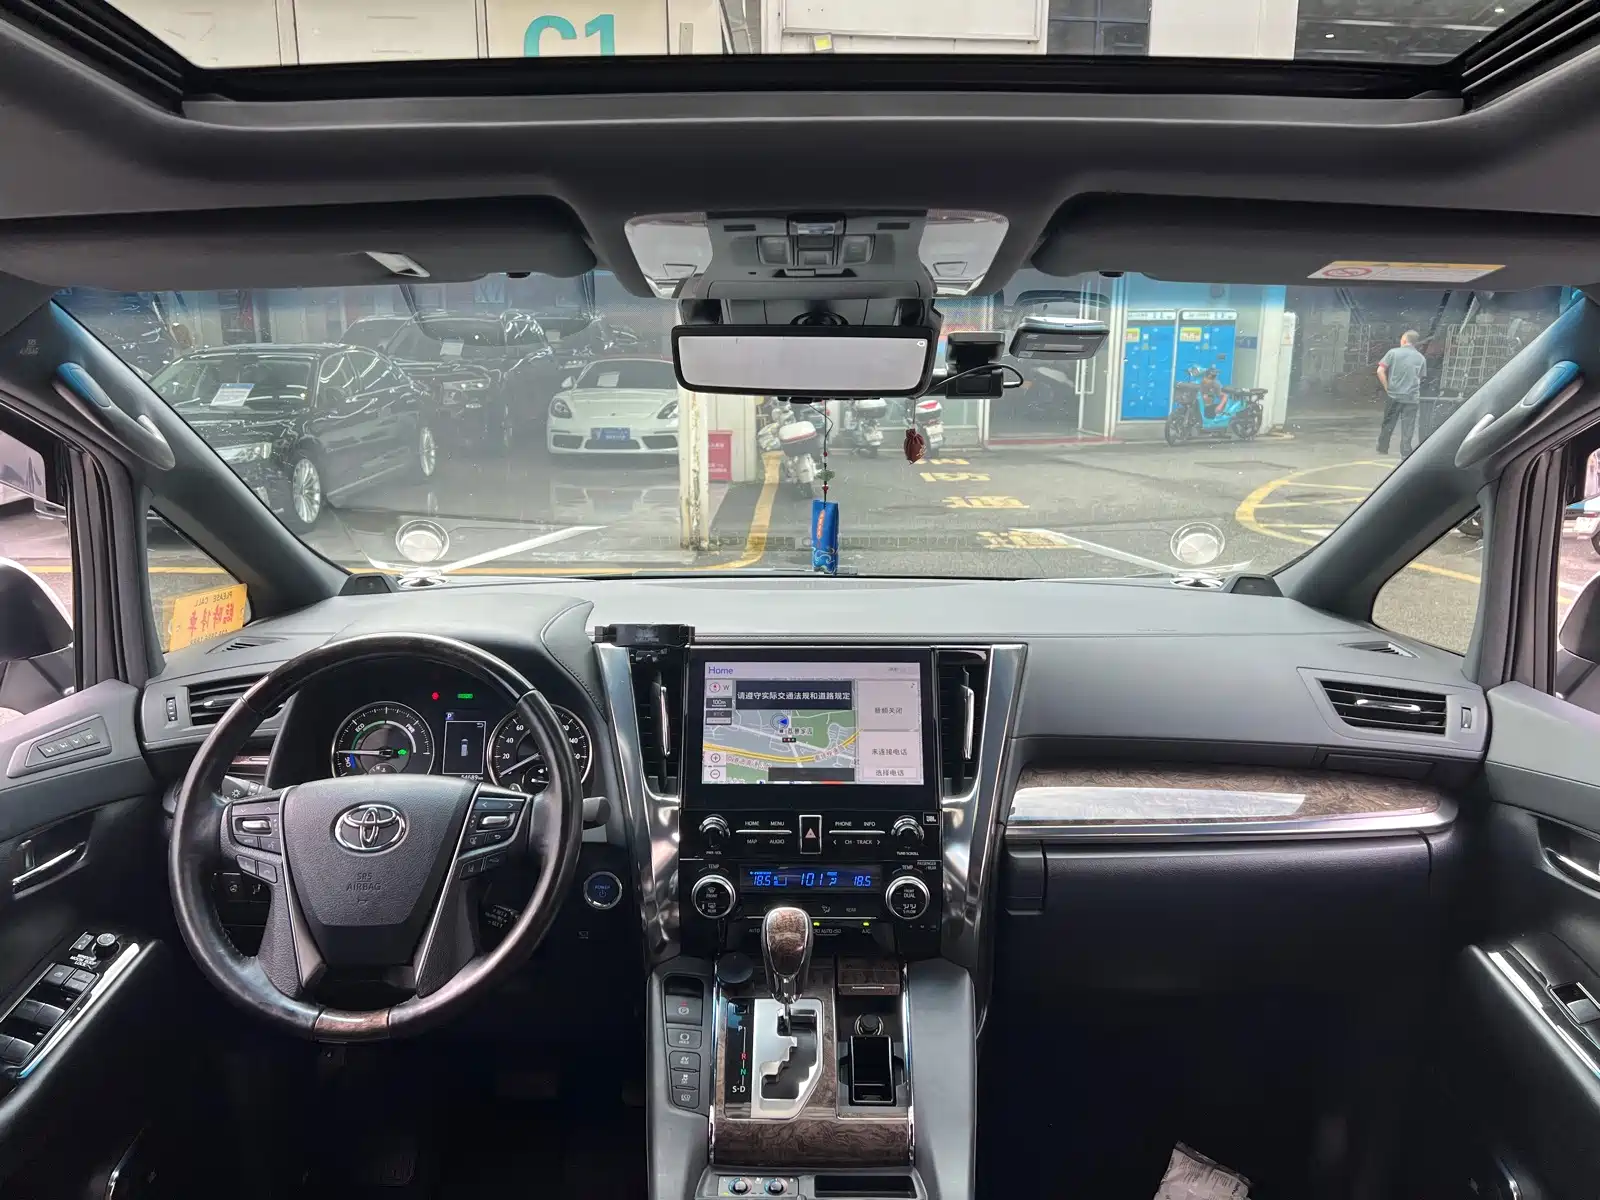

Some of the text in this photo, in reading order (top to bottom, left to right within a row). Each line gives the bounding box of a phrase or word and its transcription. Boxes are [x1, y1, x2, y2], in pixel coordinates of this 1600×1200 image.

[524, 14, 615, 57] C1
[708, 666, 734, 675] Home
[737, 691, 851, 700] 请遵守实际交通法规和道路规定
[355, 723, 365, 733] ECO
[875, 769, 905, 777] 选择电话
[357, 872, 372, 880] SRS
[753, 875, 771, 886] 18.5
[853, 876, 871, 886] 18.5
[346, 882, 381, 891] AIRBAG
